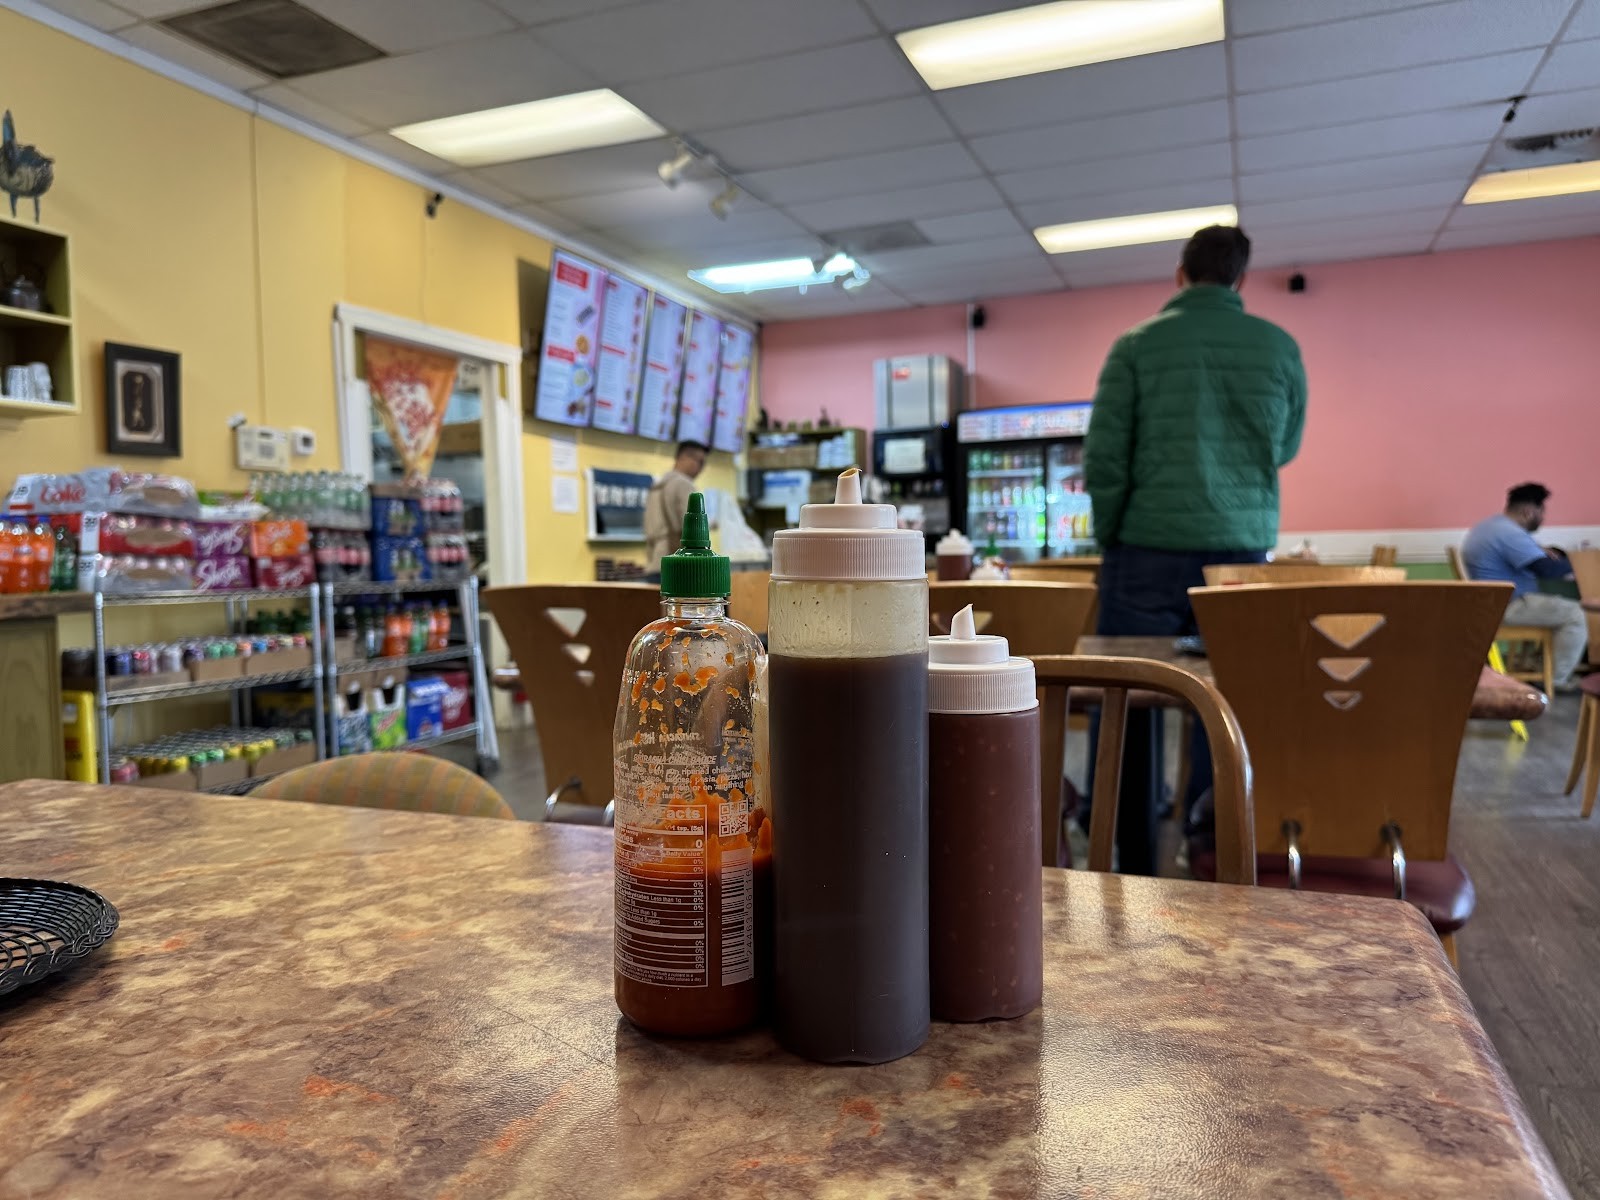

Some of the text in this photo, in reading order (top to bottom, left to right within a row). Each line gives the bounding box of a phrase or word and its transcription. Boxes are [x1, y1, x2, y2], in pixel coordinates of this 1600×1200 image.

[40, 483, 86, 504] Coke
[666, 807, 701, 819] acts
[695, 839, 703, 848] 0
